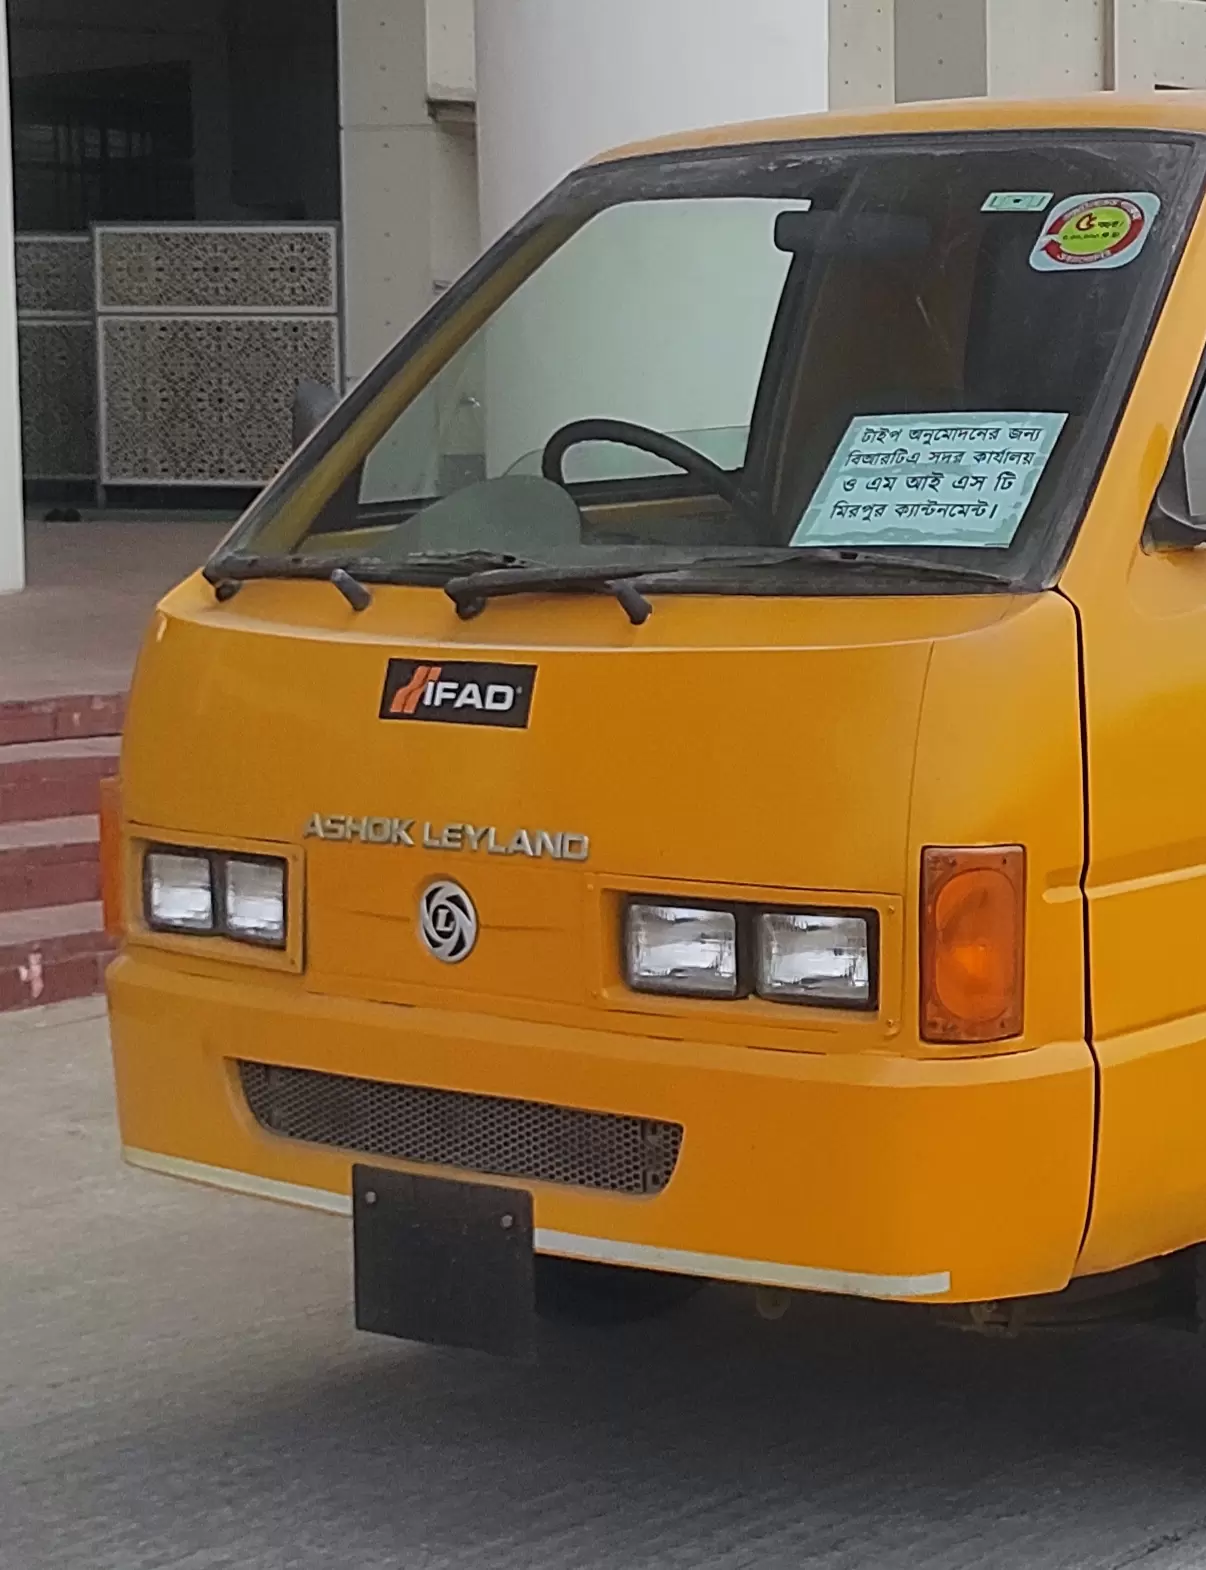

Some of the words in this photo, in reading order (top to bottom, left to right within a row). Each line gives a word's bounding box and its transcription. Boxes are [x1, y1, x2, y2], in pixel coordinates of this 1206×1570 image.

[862, 427, 903, 444] টাইপ
[909, 427, 1002, 446] অনুমোদনের
[1008, 427, 1043, 442] জন্য
[845, 448, 920, 466] বিআরটিএ
[928, 451, 967, 465] সদর
[973, 447, 1036, 465] কার্যালয়
[843, 478, 857, 492] ও
[866, 476, 899, 492] এম
[906, 471, 945, 493] আই
[952, 475, 988, 492] এস
[993, 470, 1017, 492] টি
[830, 500, 888, 522] মিরপুর
[894, 499, 999, 520] ক্যান্টনমেন্ট।
[423, 681, 514, 710] IFAD
[304, 813, 415, 847] ASHOK
[423, 821, 589, 861] LEYLAND
